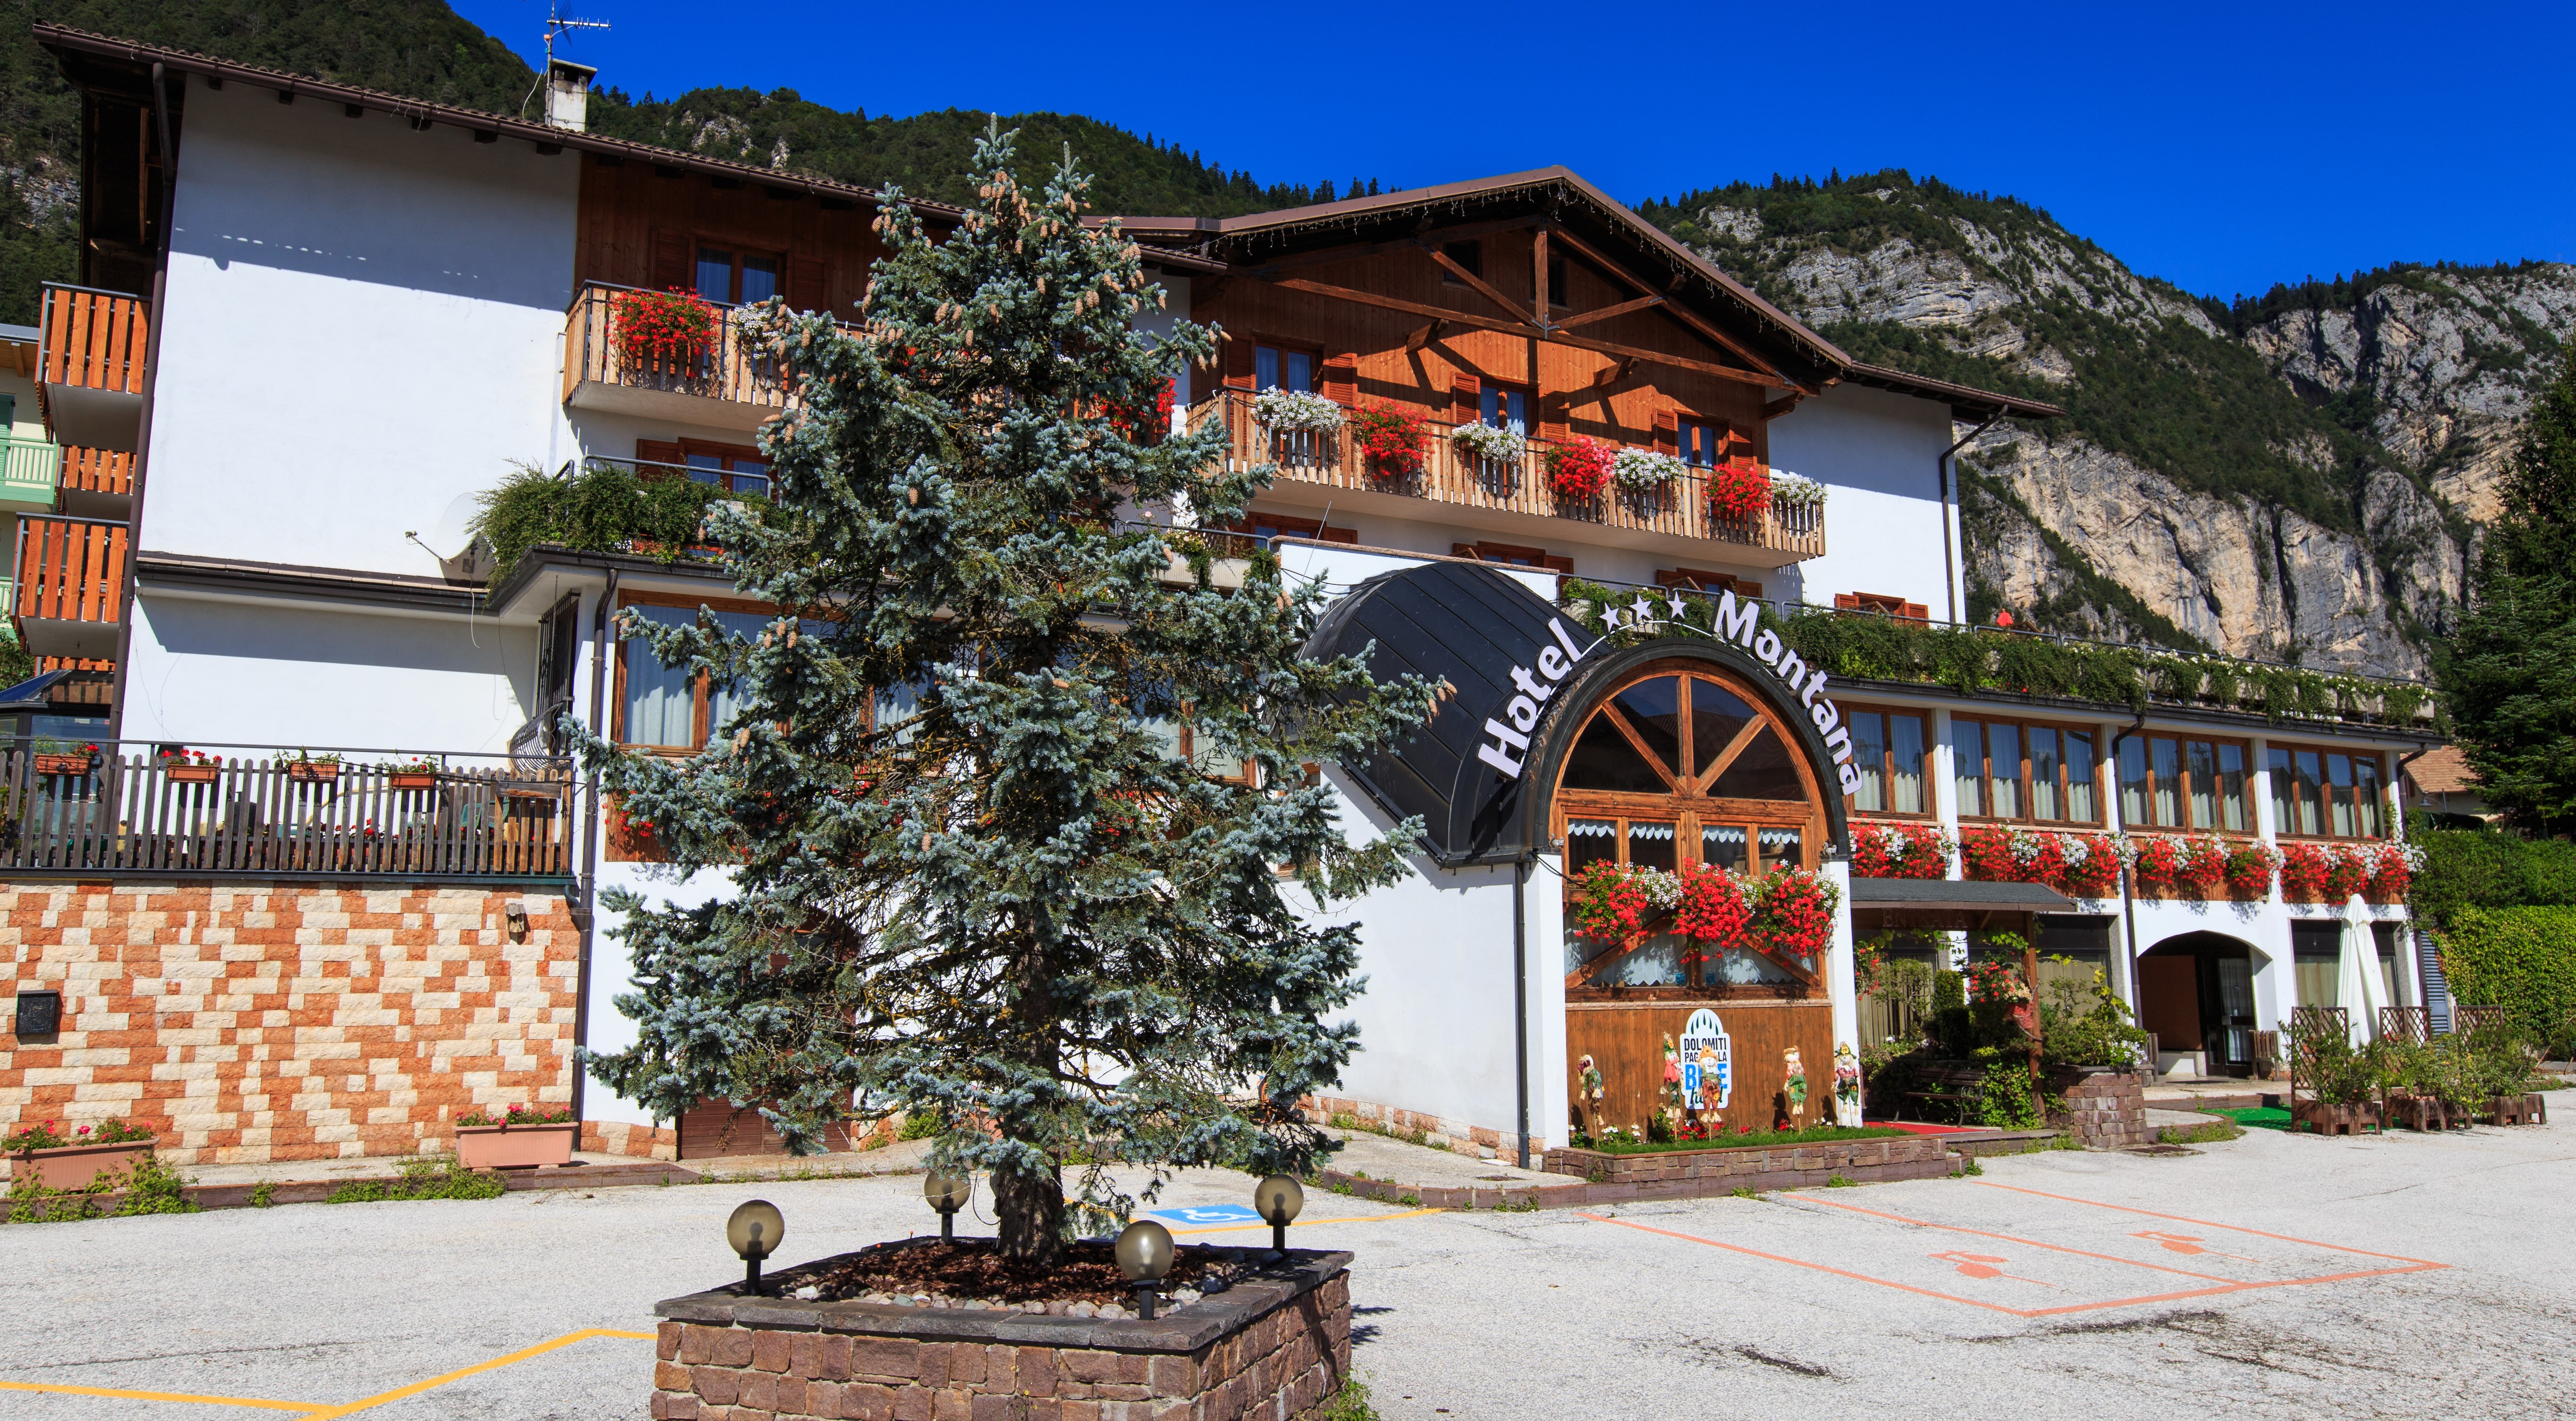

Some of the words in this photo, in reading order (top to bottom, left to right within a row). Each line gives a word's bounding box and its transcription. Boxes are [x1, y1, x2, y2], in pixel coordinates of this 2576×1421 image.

[1478, 617, 1582, 779] Hotel
[1711, 589, 1863, 796] Montana
[1882, 907, 1968, 928] ENTRATA
[1684, 1038, 1727, 1051] DOLOMITI
[1684, 1052, 1727, 1063] PAGLA
[1685, 1064, 1728, 1090] BIE
